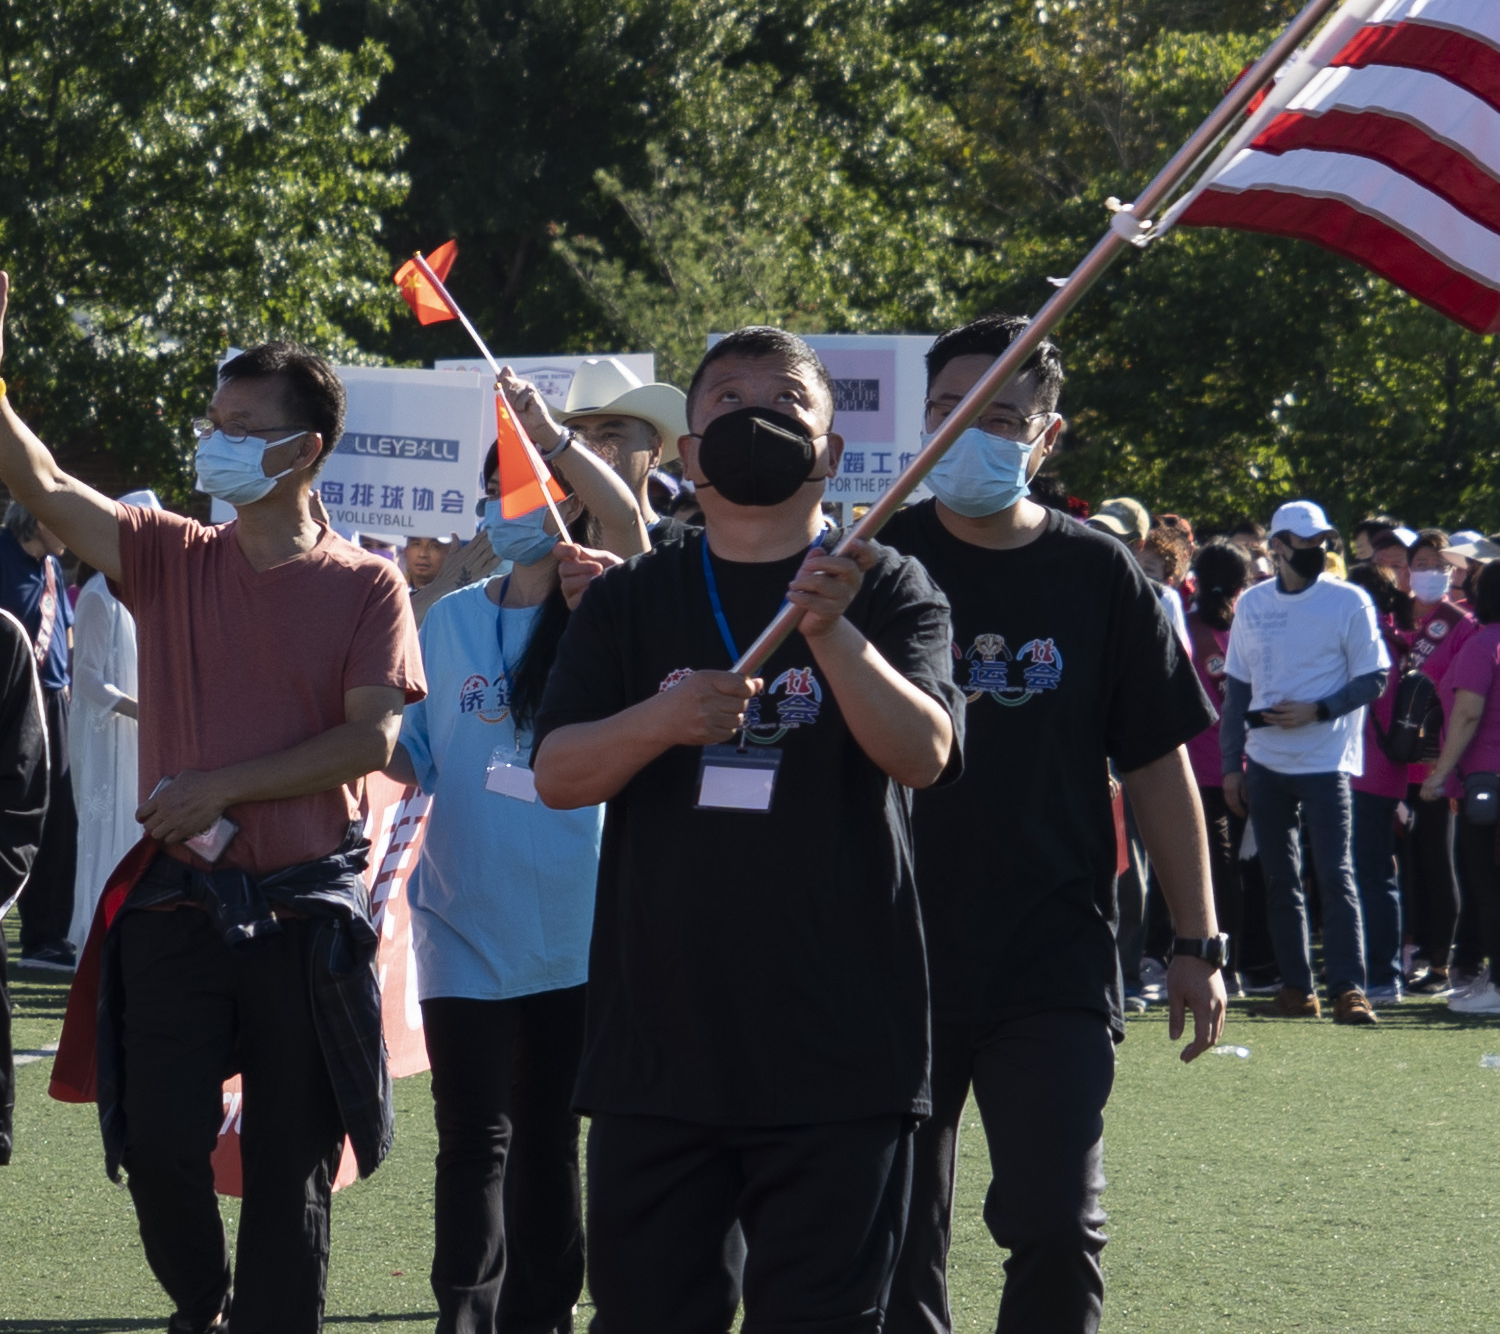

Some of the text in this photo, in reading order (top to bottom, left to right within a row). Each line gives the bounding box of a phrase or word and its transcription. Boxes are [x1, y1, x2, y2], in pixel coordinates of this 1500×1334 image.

[835, 400, 870, 411] OPLE
[828, 477, 851, 492] FOR
[854, 478, 875, 492] THE
[321, 481, 464, 514] 岛排球协会
[336, 510, 415, 528] VOLLEYBALL
[968, 660, 1062, 689] 运会
